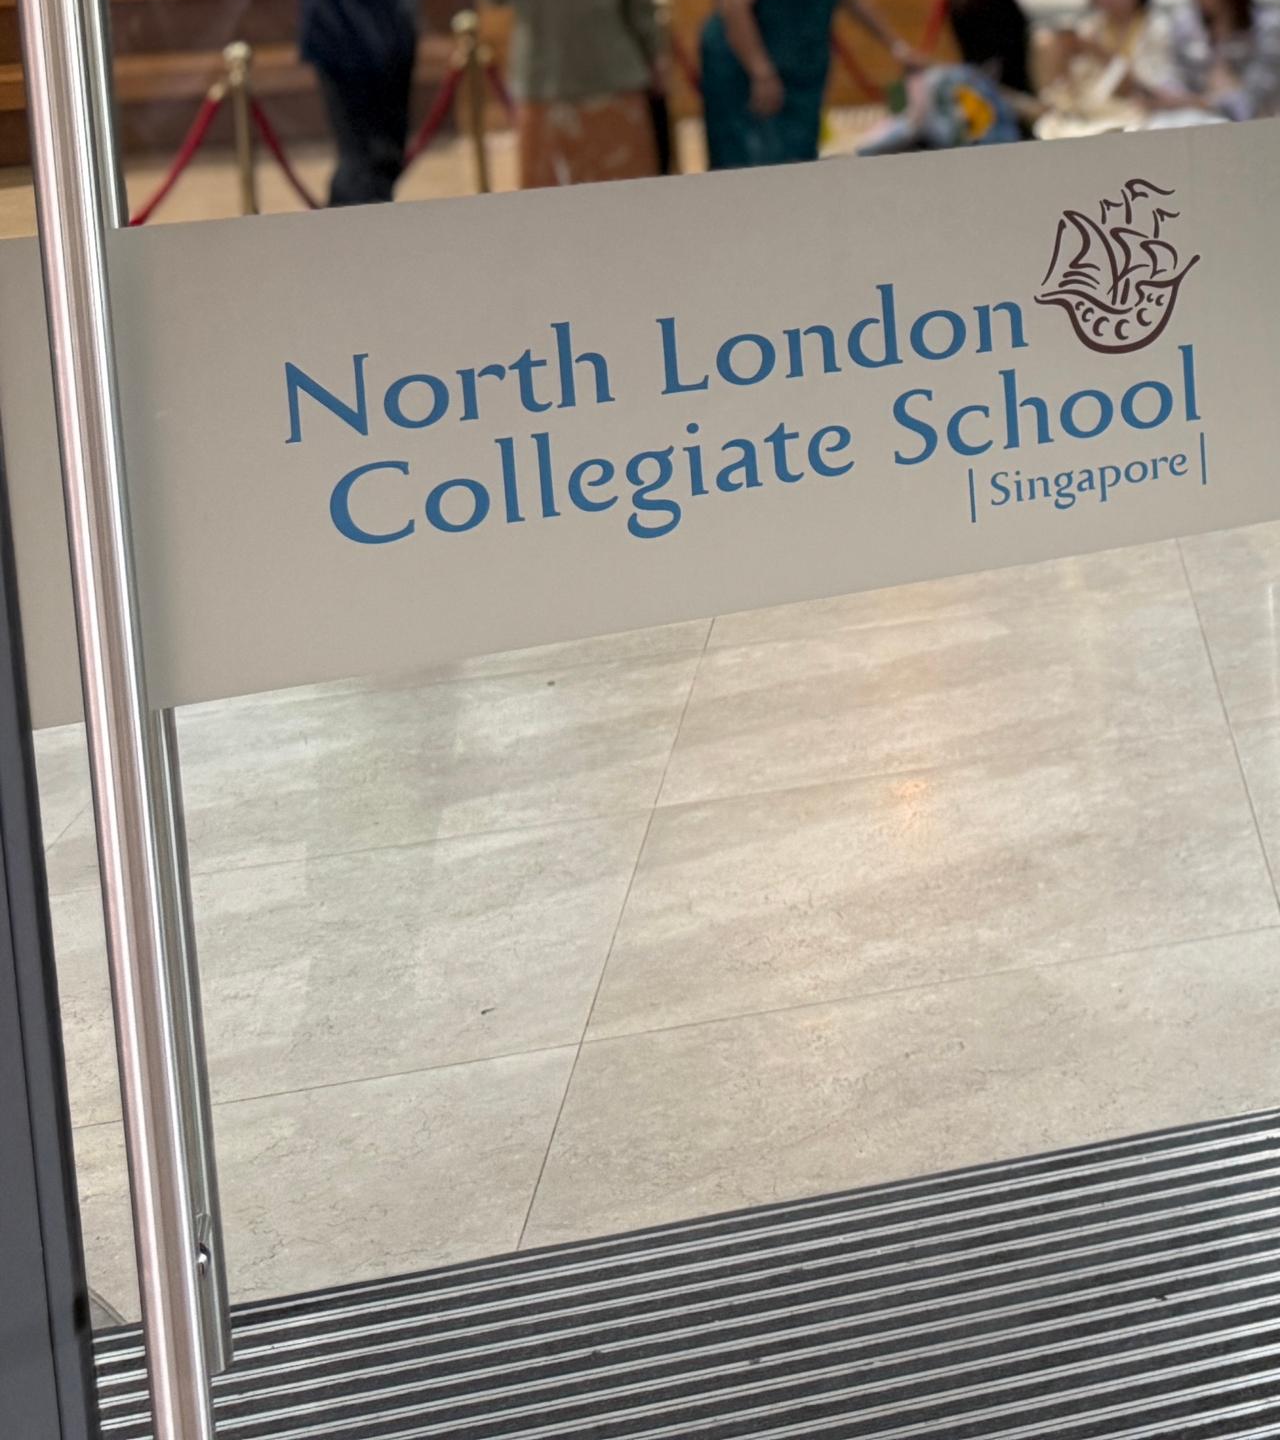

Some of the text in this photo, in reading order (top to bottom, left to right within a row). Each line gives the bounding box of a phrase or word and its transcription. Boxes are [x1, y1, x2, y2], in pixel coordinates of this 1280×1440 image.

[283, 282, 1030, 445] North London
[327, 343, 1202, 547] Collegiate School
[987, 448, 1189, 511] Singapore
